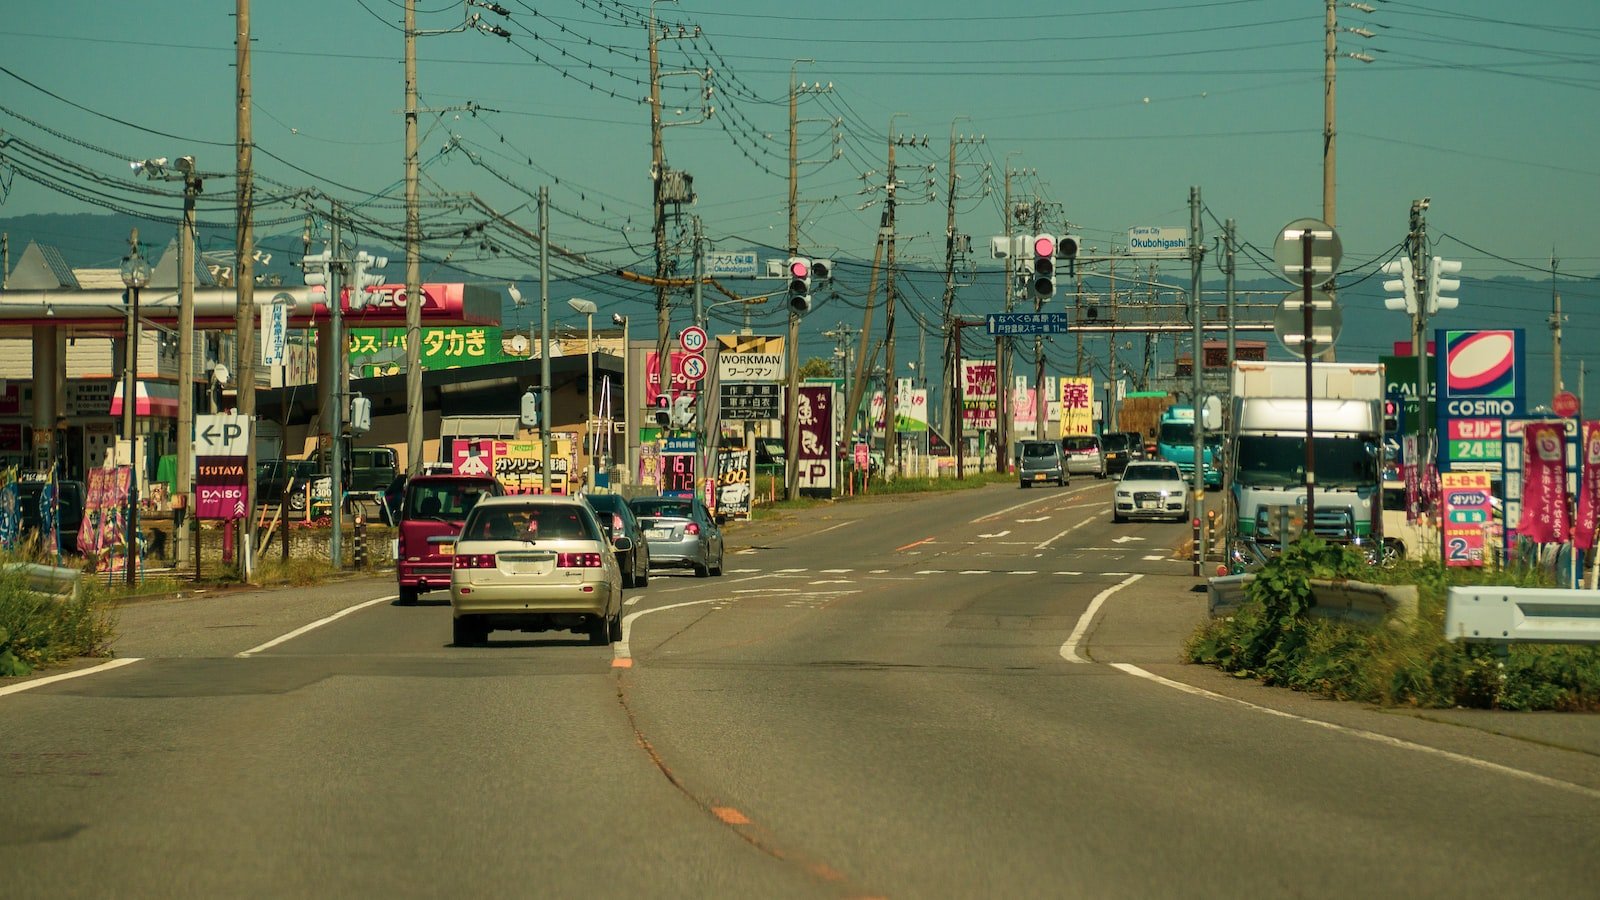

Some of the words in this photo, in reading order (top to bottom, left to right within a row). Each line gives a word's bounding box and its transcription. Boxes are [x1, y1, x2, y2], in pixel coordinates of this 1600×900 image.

[1131, 238, 1186, 249] Okubohigashi
[715, 256, 753, 265] 大久保東
[686, 335, 701, 346] 50
[720, 355, 781, 365] WORKMAN
[728, 368, 772, 377] ワークマン
[1447, 400, 1515, 416] COSMO
[729, 410, 771, 419] ユニフォーム
[1076, 424, 1089, 433] IN
[224, 423, 242, 447] P
[673, 455, 694, 473] 161
[199, 466, 244, 476] TSUTAYA
[810, 464, 826, 485] P
[673, 473, 694, 491] 172
[202, 490, 242, 499] DAISO
[1452, 495, 1485, 505] ガソリン
